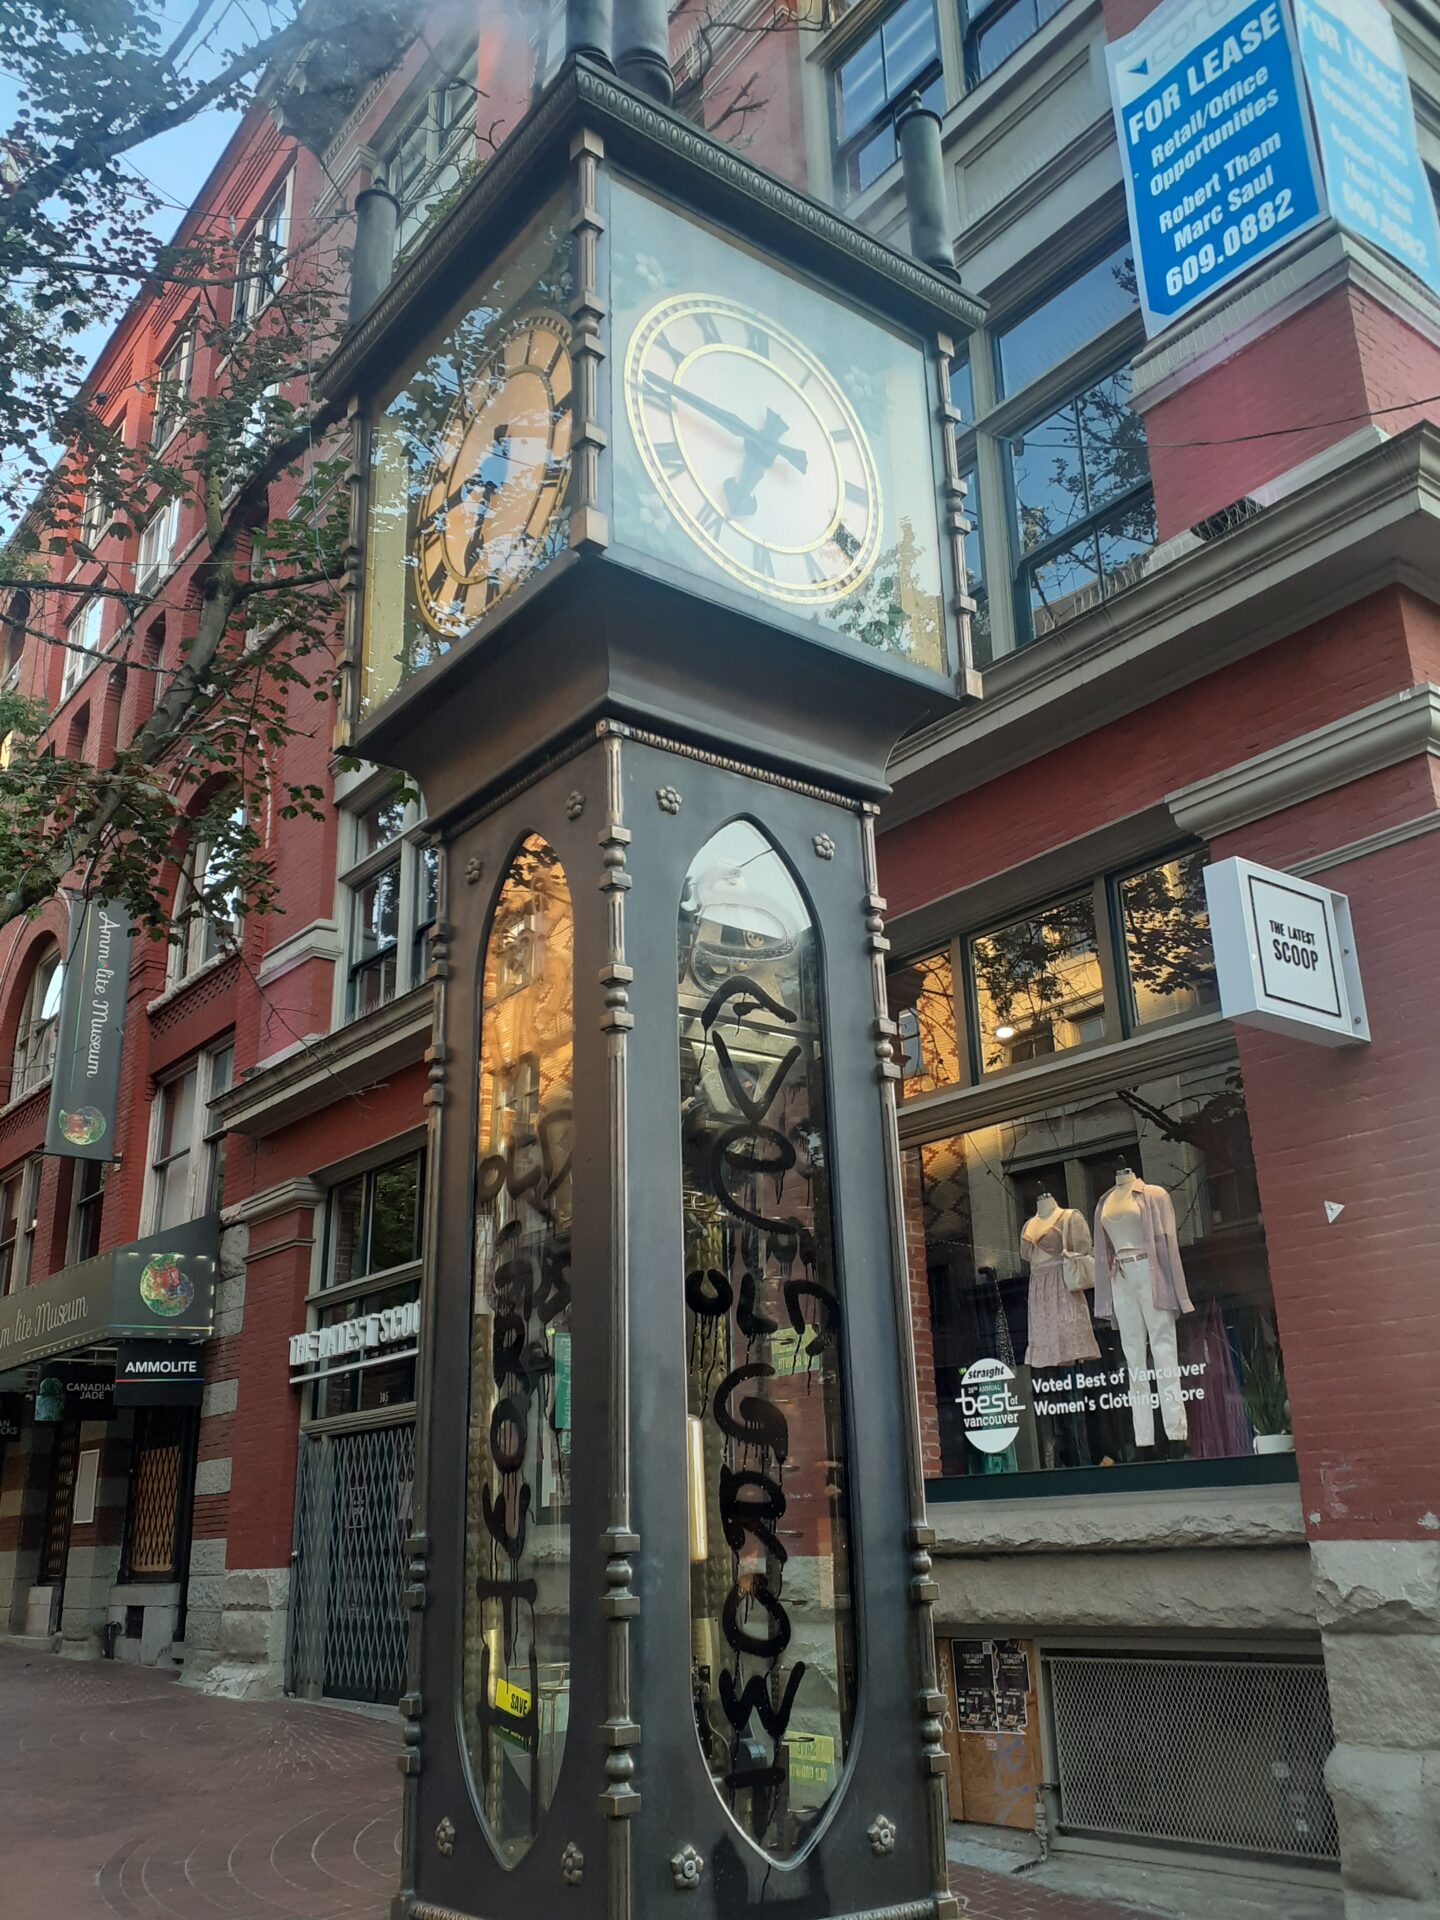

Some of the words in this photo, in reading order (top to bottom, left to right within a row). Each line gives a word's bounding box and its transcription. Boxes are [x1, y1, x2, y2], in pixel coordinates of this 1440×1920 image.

[1128, 84, 1181, 146] FOR
[1186, 3, 1281, 97] LEASE
[1150, 66, 1269, 168] Retail/Office
[1149, 88, 1279, 197] Opportunities
[1159, 172, 1221, 234] Robert
[1224, 132, 1282, 184] Tham
[1173, 206, 1223, 253] Marc
[1227, 166, 1274, 214] Saul
[1165, 188, 1294, 297] 609.0882
[1269, 920, 1286, 937] THE
[1287, 926, 1316, 946] LATEST
[1272, 938, 1319, 971] SCOOP
[86, 999, 111, 1079] Museum
[34, 1296, 89, 1337] Museum
[124, 1360, 198, 1374] AMMOLITE
[967, 1365, 1005, 1380] straight
[1032, 1374, 1073, 1395] Voted
[1075, 1371, 1107, 1391] Best
[1109, 1367, 1125, 1386] of
[1128, 1362, 1207, 1383] Vancouver
[79, 1391, 105, 1400] JADE
[955, 1382, 1027, 1416] best
[1009, 1394, 1019, 1406] of
[1033, 1396, 1097, 1418] Women's
[1098, 1391, 1161, 1411] Clothing
[1163, 1387, 1206, 1404] Store
[963, 1412, 1019, 1429] vancouver
[510, 1693, 529, 1716] SAVE
